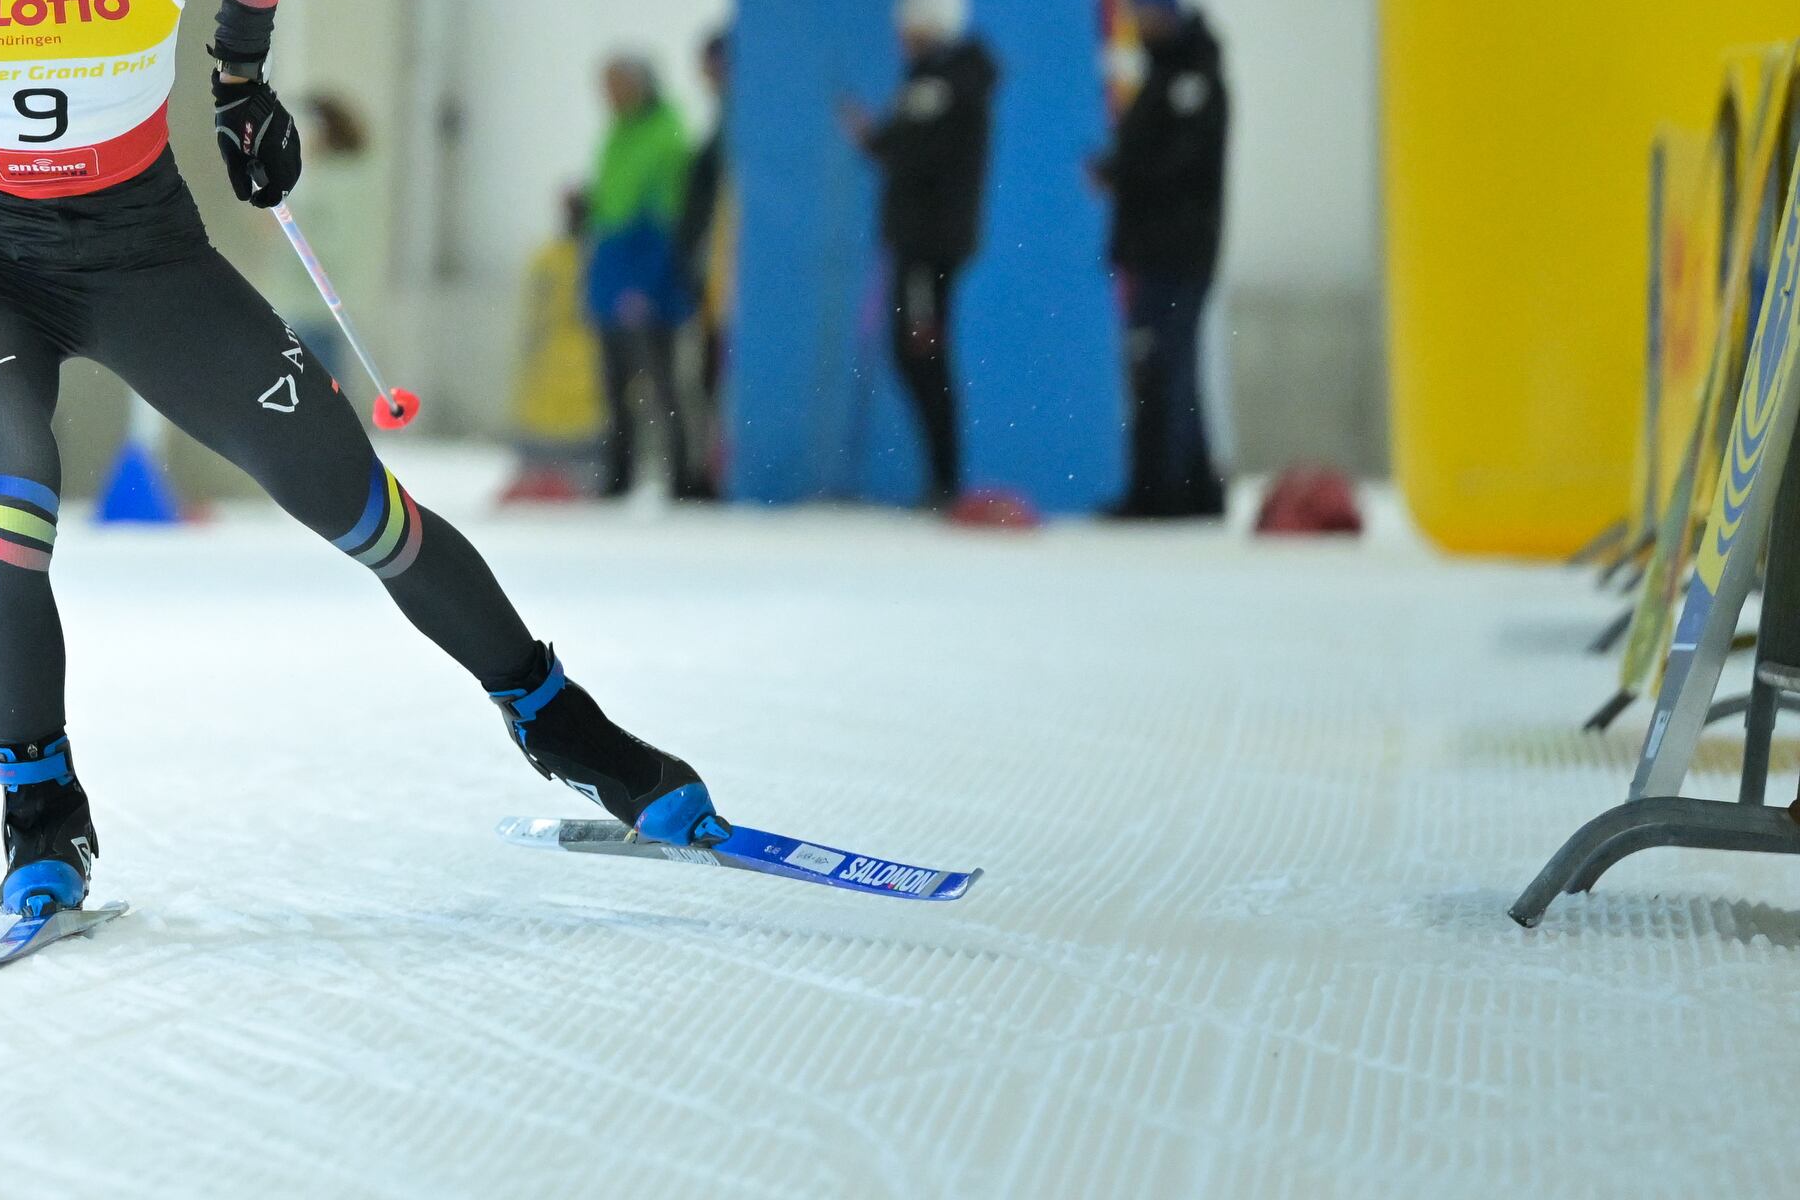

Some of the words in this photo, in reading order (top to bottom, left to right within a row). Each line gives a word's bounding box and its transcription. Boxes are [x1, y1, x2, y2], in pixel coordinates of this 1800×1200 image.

[28, 62, 104, 80] Grand
[112, 52, 158, 77] Prix
[12, 87, 69, 143] 9
[7, 162, 87, 173] antenne
[839, 856, 939, 895] SALOMON
